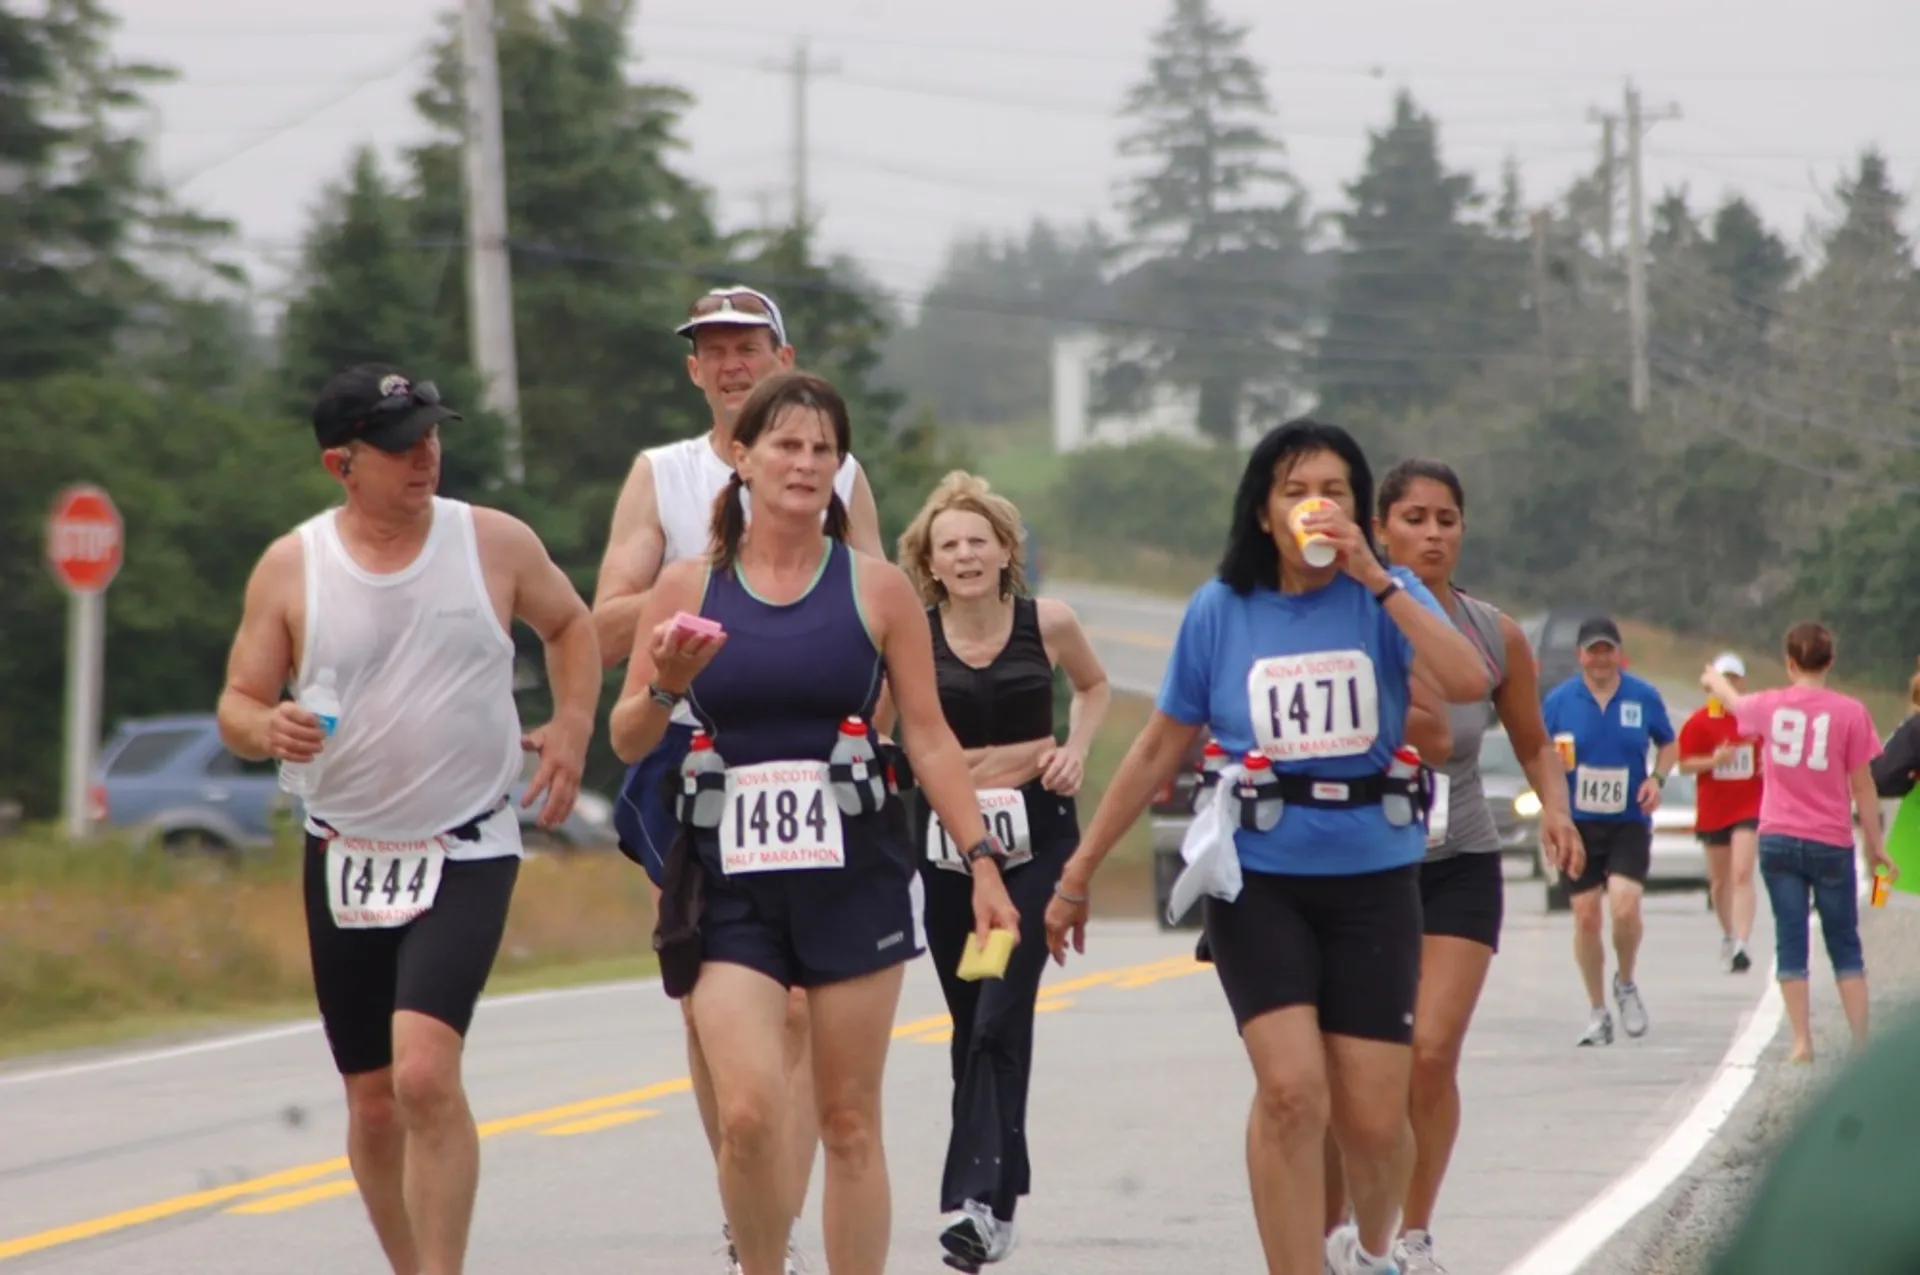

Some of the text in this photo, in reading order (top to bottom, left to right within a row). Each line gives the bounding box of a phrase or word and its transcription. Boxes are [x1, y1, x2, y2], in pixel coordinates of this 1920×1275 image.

[50, 523, 118, 561] STOP
[1265, 657, 1357, 677] NOVA SCOTIA
[1268, 676, 1360, 738] 1471
[1299, 733, 1373, 752] MARATHON
[1771, 705, 1831, 772] 91
[736, 769, 822, 786] NOVA SCOTIA
[1581, 779, 1622, 803] 1426
[735, 789, 827, 849] 1484
[726, 848, 839, 866] HALF MARATHON
[341, 855, 428, 906] 1444
